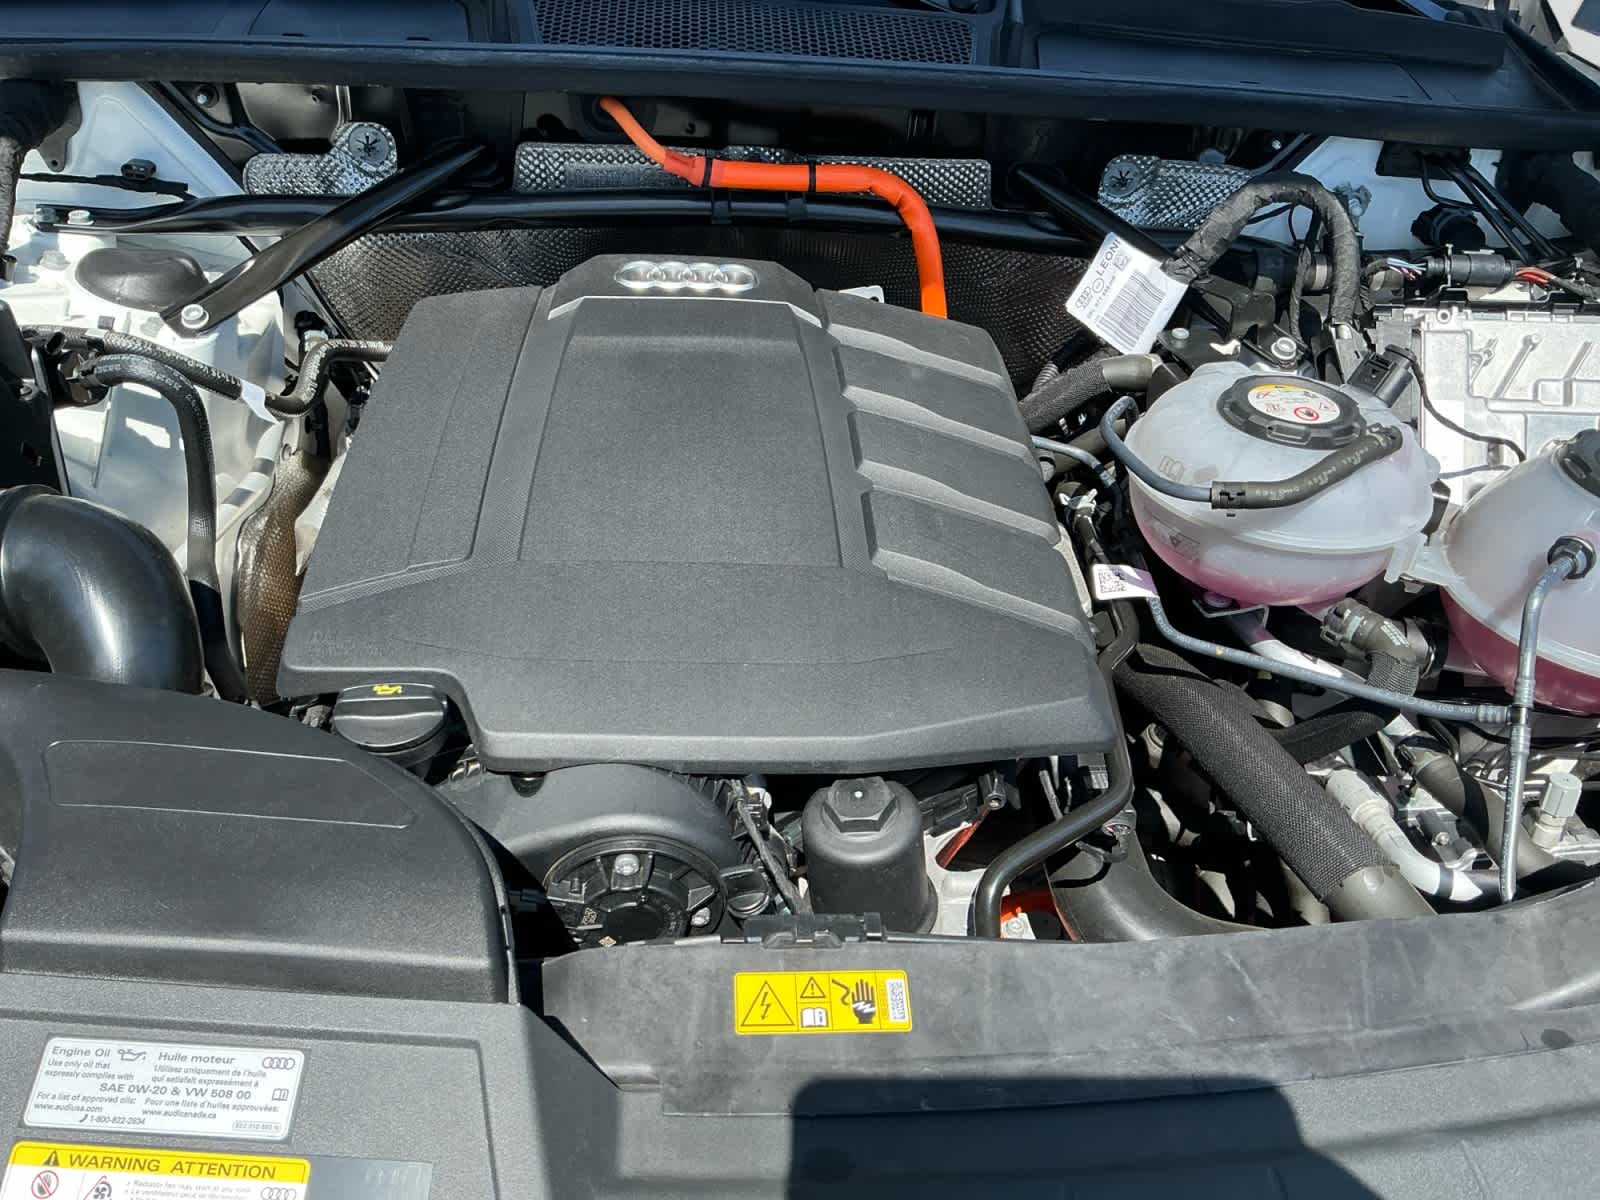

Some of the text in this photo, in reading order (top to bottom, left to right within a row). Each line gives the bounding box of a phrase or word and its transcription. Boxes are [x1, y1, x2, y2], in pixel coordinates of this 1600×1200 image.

[1096, 239, 1121, 276] LEONI
[52, 1046, 111, 1058] Engine Oil
[48, 1058, 111, 1070] Use only oil that
[158, 1052, 236, 1065] Huile moteur
[44, 1069, 134, 1081] expressly complies with
[183, 1066, 230, 1077] uniquement
[232, 1069, 242, 1077] de
[151, 1075, 164, 1084] qui
[99, 1082, 252, 1100] SAE 0W-20 & VW 508 00
[36, 1091, 50, 1100] For
[58, 1092, 71, 1101] list
[71, 1093, 81, 1101] of
[82, 1094, 118, 1104] approved
[144, 1097, 167, 1106] Pour
[168, 1099, 180, 1107] une
[181, 1098, 198, 1108] liste
[33, 1102, 103, 1113] www.audiusa.com
[69, 1153, 277, 1179] WARNING ATTENTION
